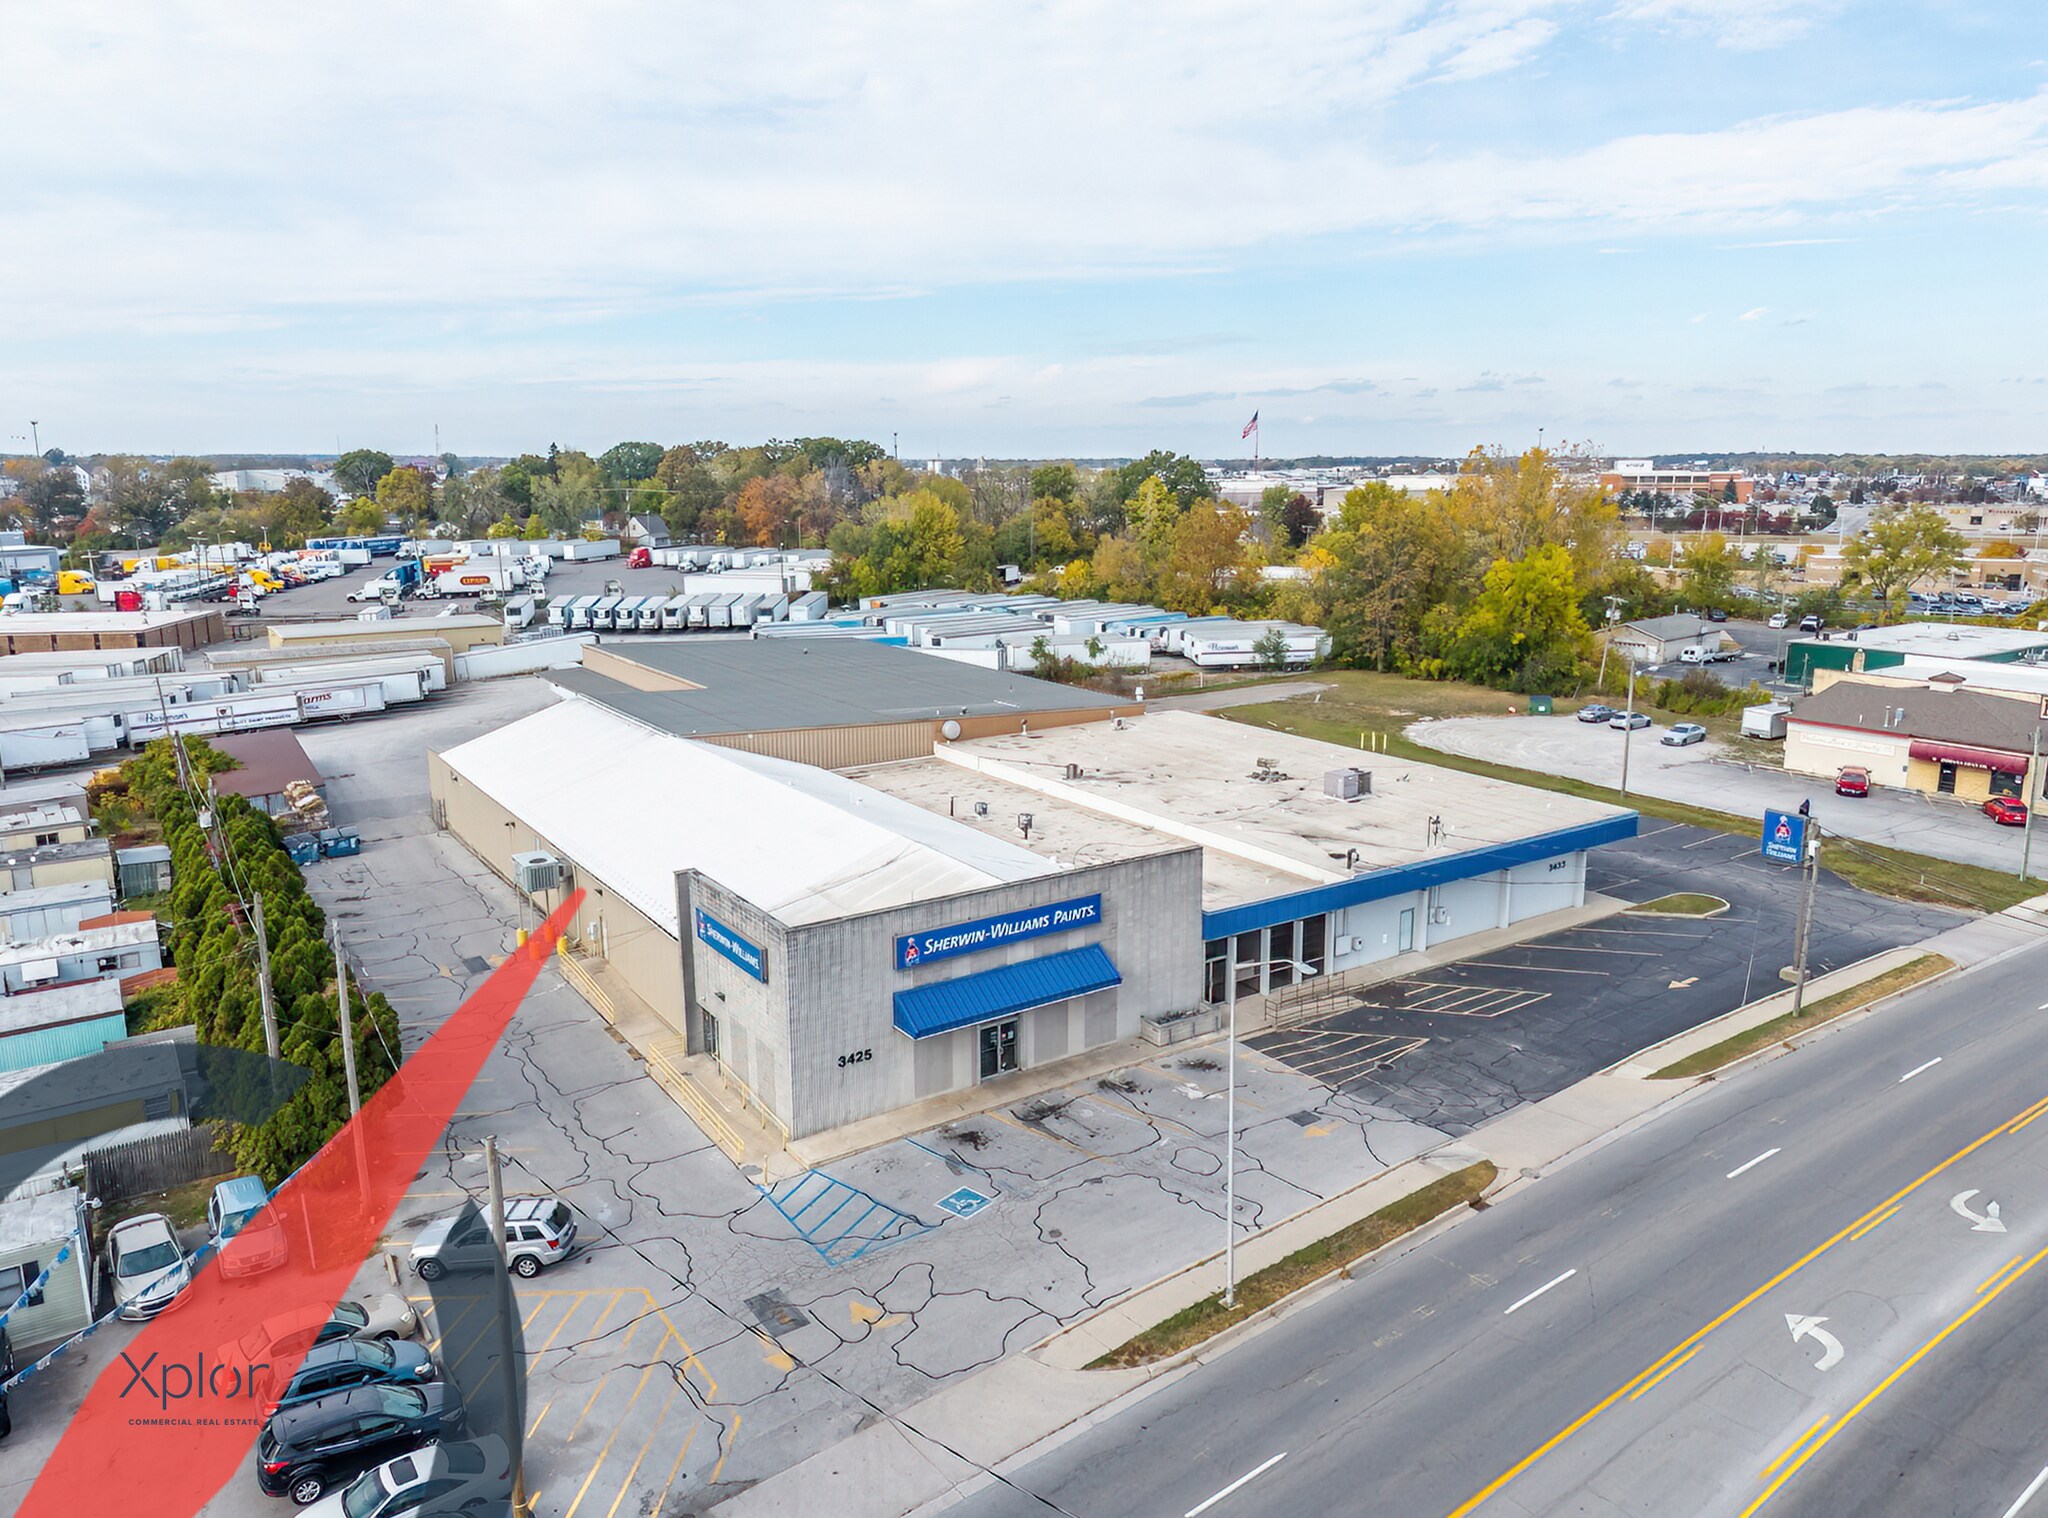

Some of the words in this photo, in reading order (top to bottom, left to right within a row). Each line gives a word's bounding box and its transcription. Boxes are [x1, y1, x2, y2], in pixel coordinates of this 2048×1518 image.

[303, 692, 332, 704] arms
[924, 914, 1050, 955] SHERWIN-WILLIAMS
[838, 1048, 872, 1067] 3425
